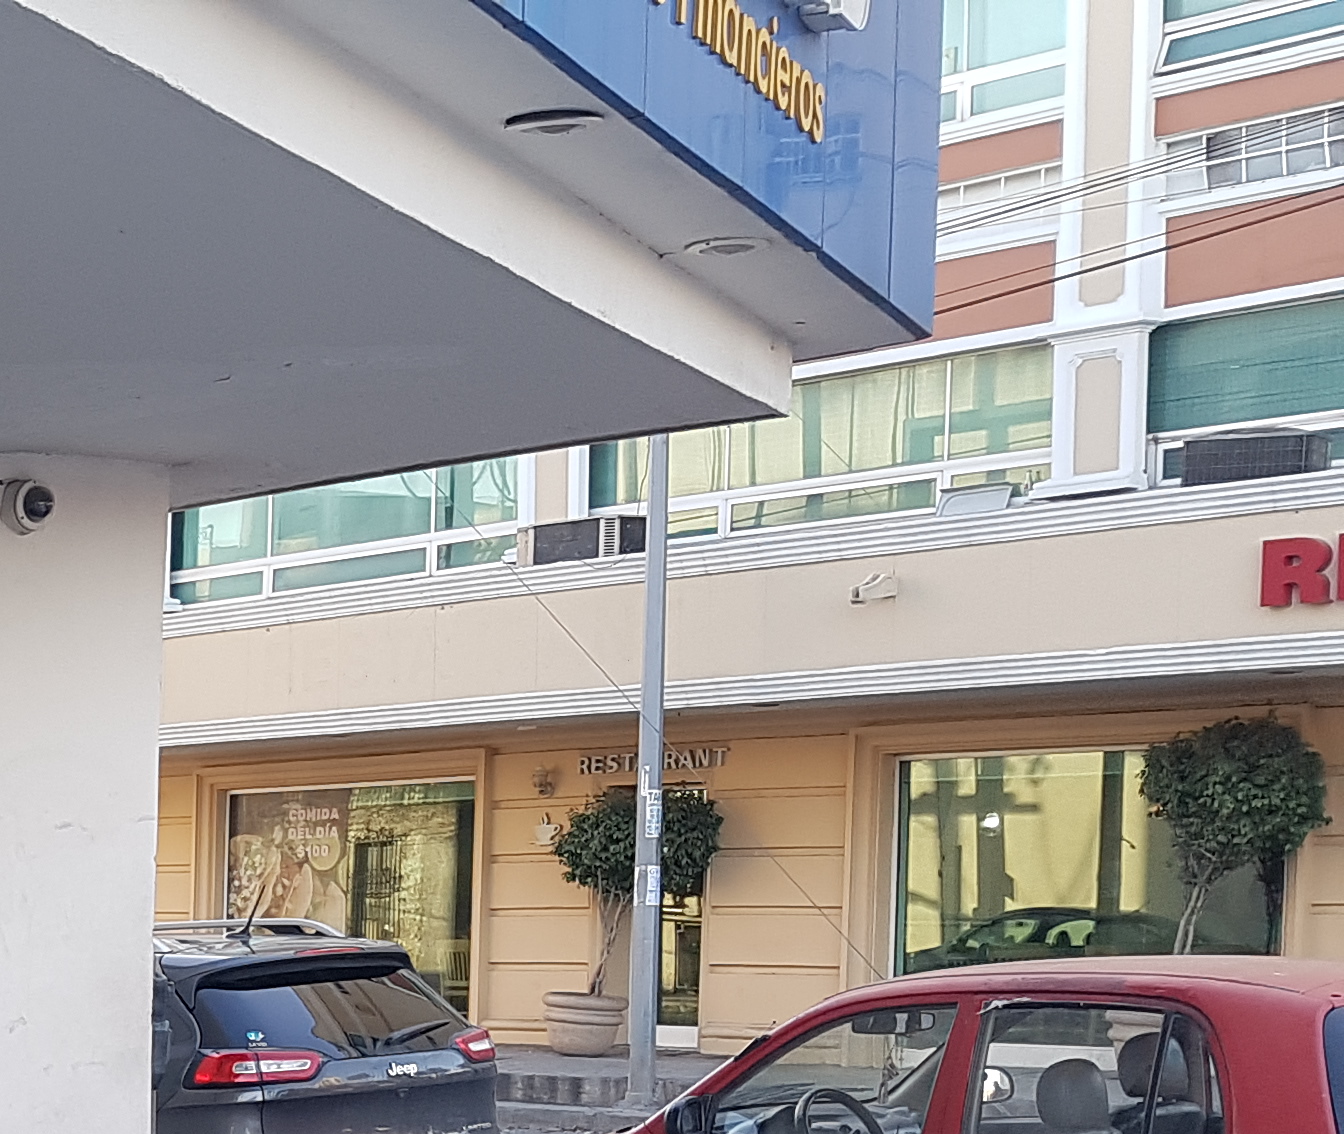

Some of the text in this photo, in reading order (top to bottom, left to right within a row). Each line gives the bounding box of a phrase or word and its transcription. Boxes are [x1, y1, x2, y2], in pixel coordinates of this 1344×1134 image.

[675, 0, 825, 143] nancieros
[1260, 532, 1344, 607] R
[577, 747, 728, 776] RESTRANT
[288, 806, 340, 821] COMIDA
[287, 822, 339, 839] DEL DÍA
[387, 1062, 419, 1077] Jeep
